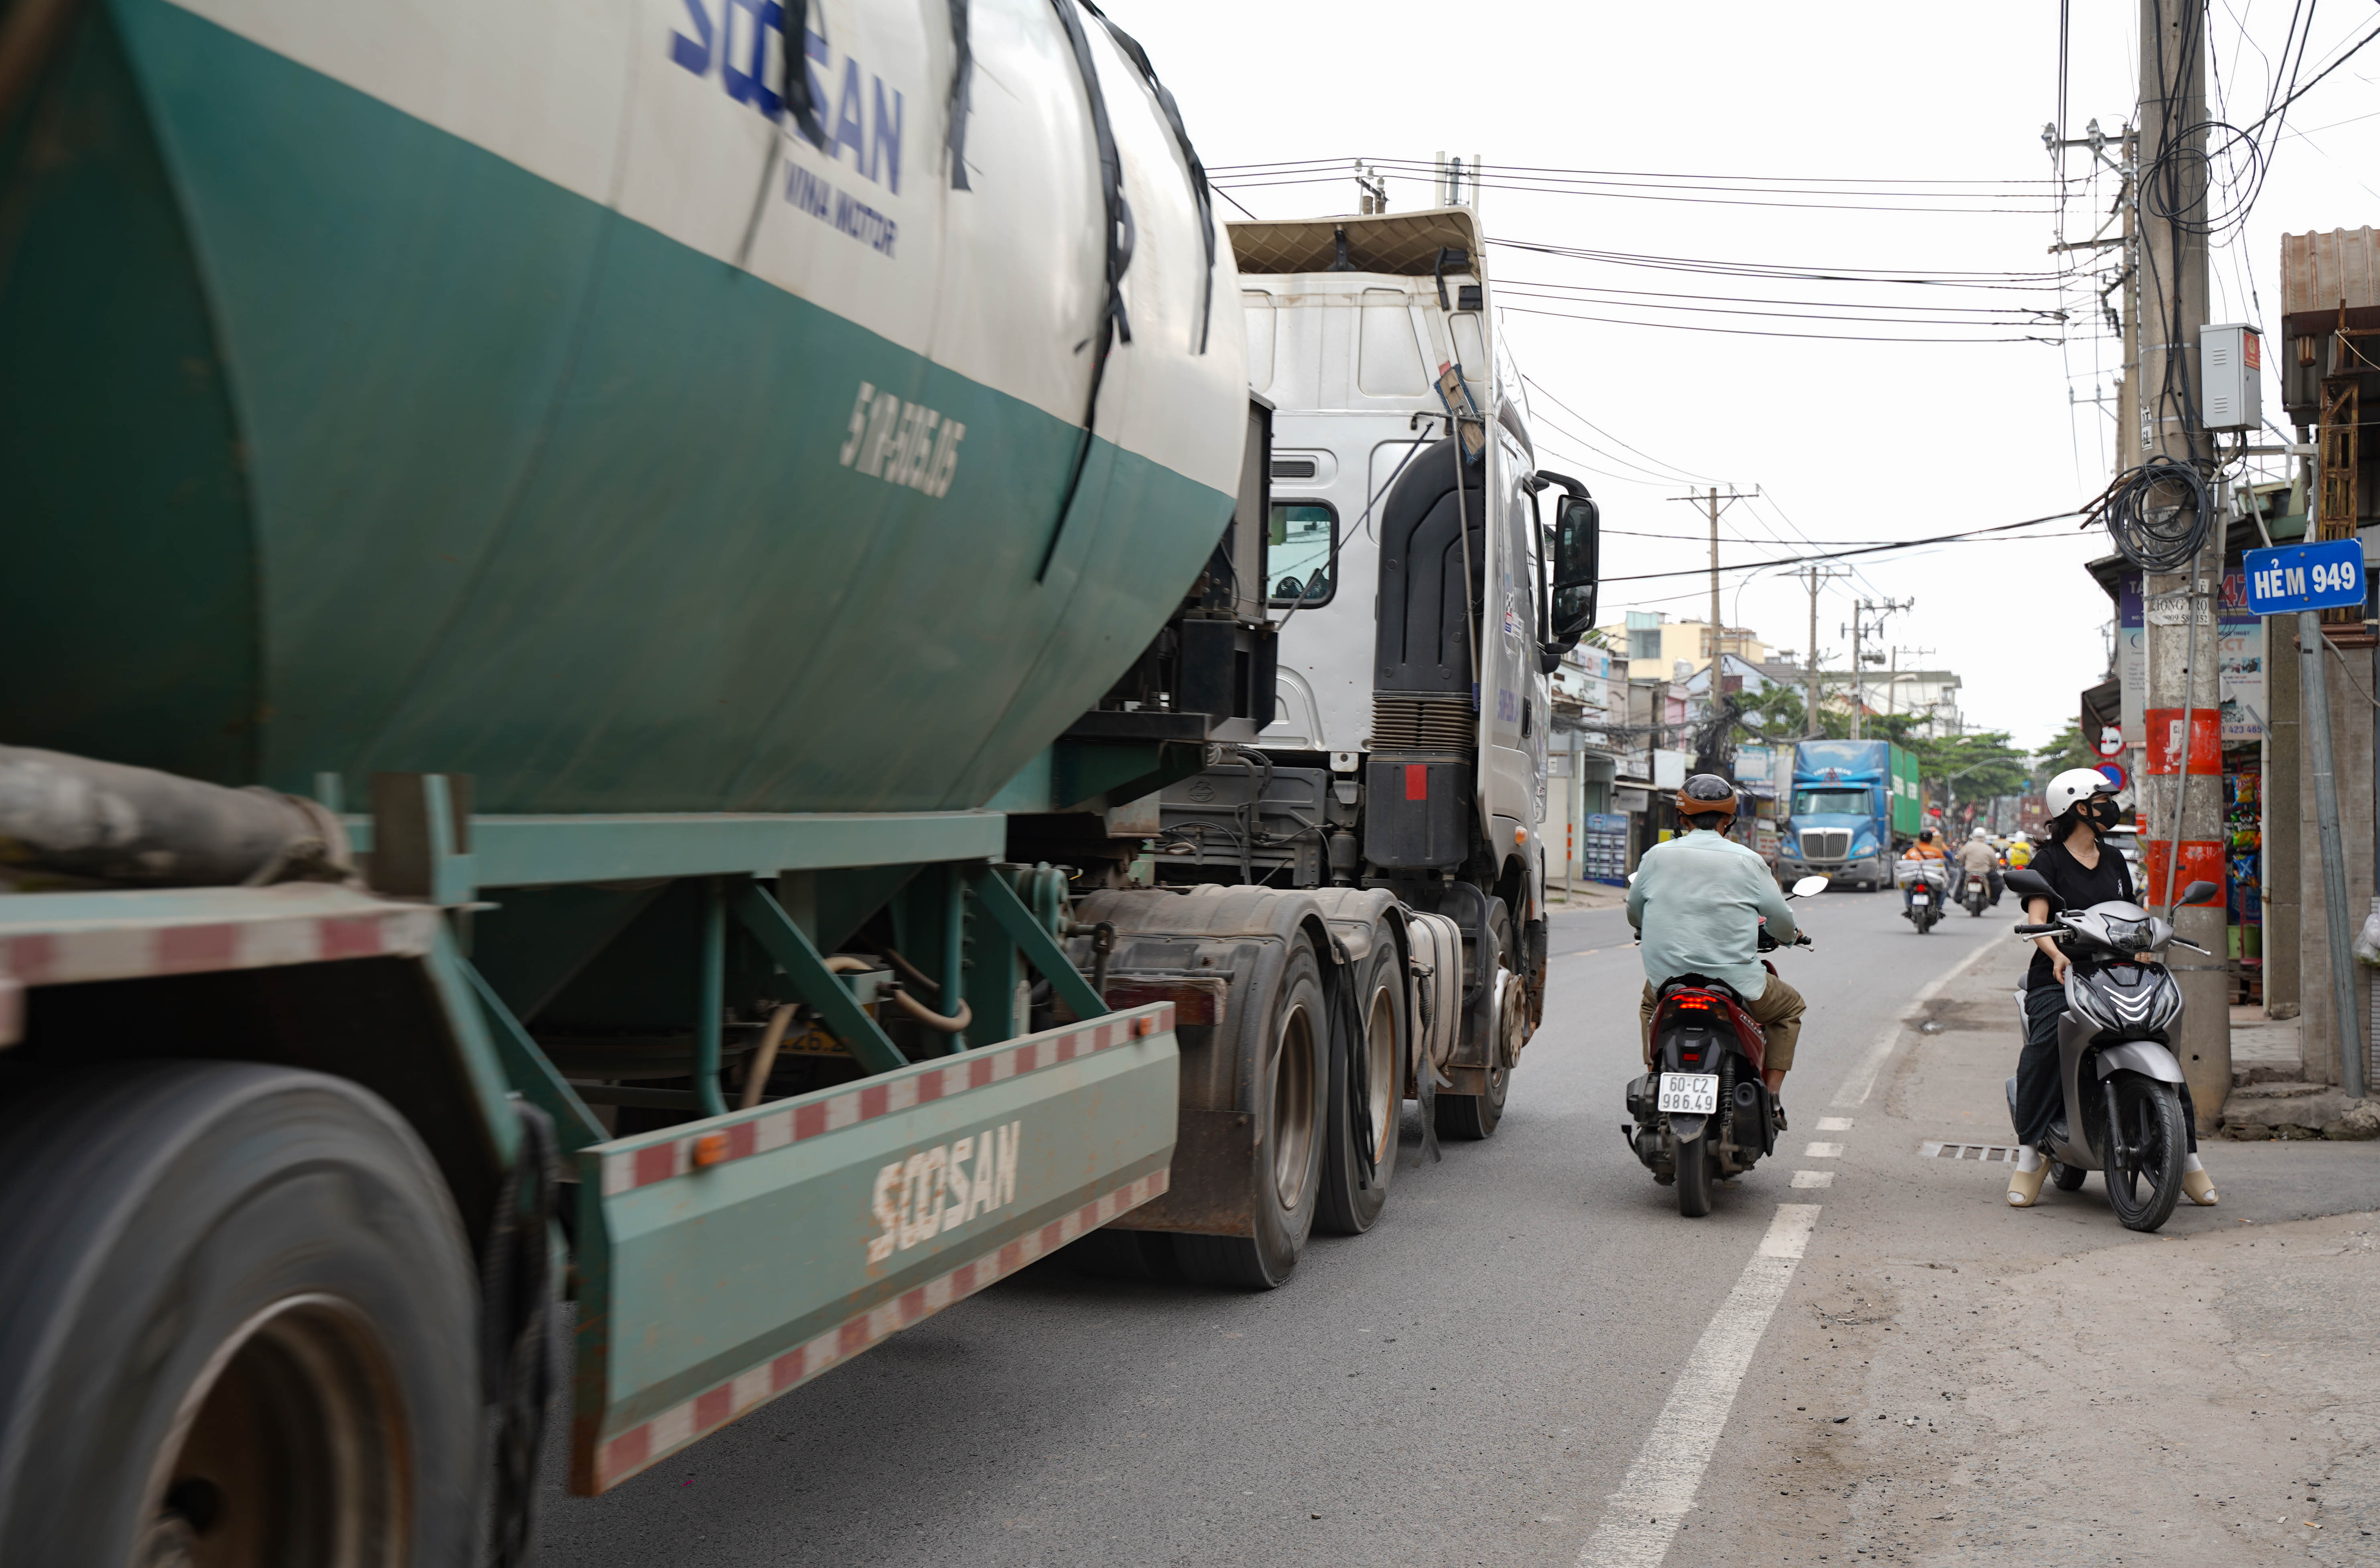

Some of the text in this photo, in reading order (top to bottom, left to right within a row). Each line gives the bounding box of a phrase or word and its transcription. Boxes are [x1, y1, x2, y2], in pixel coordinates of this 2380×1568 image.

[2254, 558, 2356, 599] HẺM 949
[2229, 725, 2244, 733] 423
[1669, 1077, 1708, 1093] 60-C2
[1663, 1093, 1712, 1110] 986.49
[866, 1120, 1021, 1266] SOOSAN
